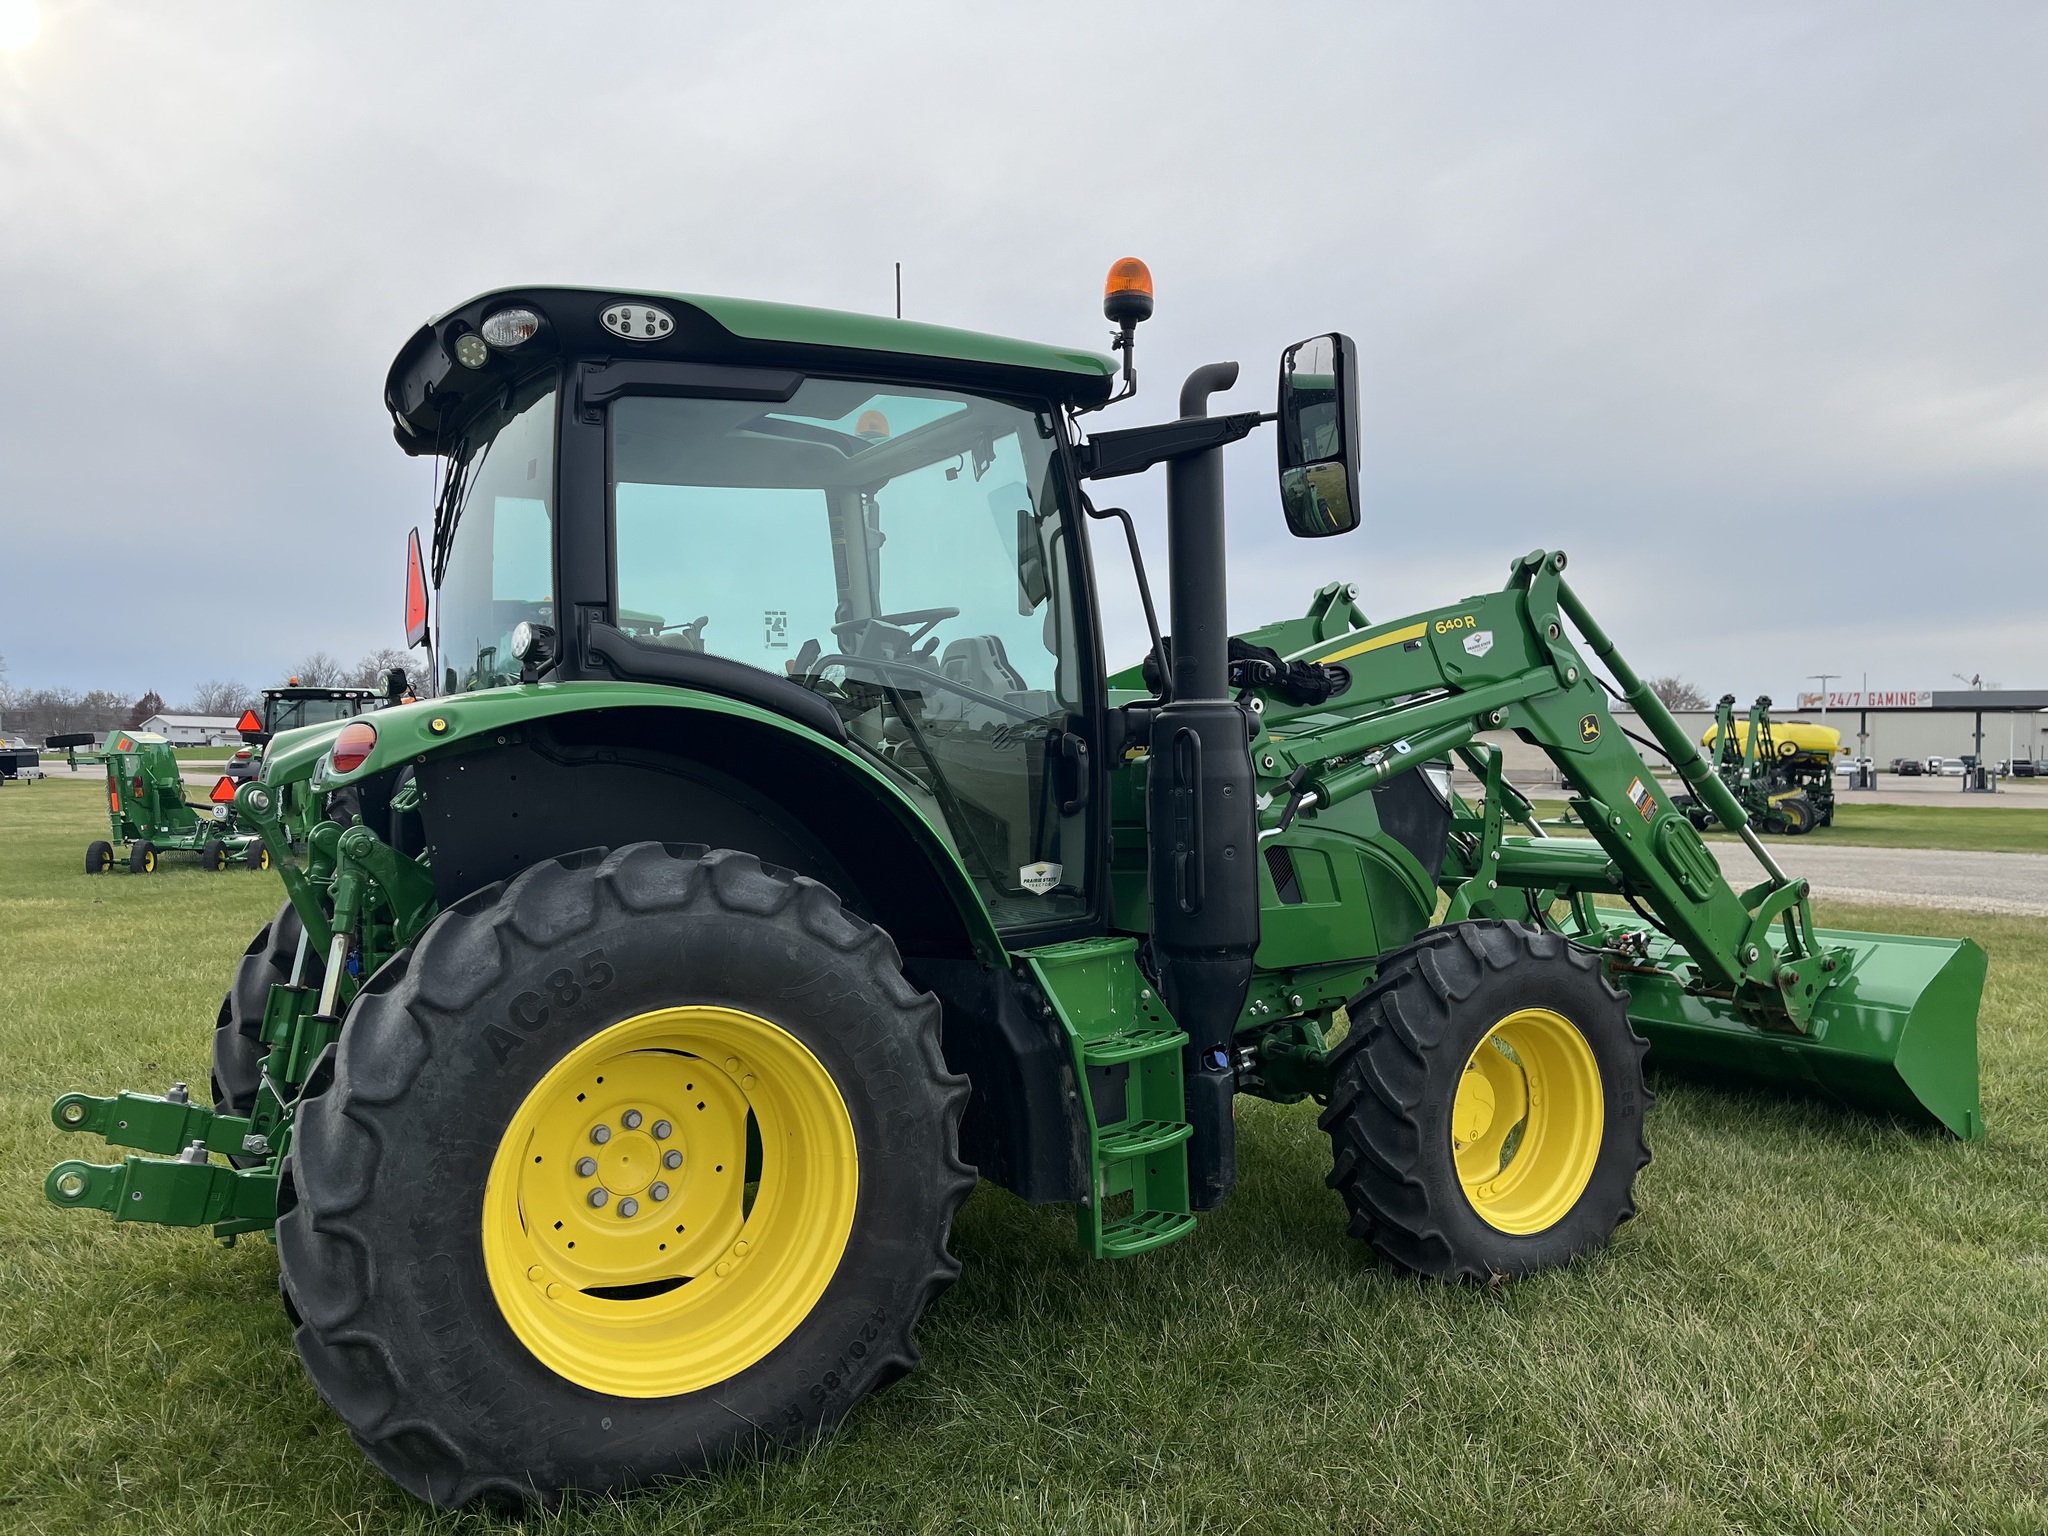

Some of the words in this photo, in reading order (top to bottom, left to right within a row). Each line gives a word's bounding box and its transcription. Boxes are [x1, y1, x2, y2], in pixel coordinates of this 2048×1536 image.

[1829, 692, 1861, 707] 24/7
[1868, 691, 1917, 706] GAMING
[479, 948, 615, 1068] AC85
[809, 1305, 887, 1406] 420/85
